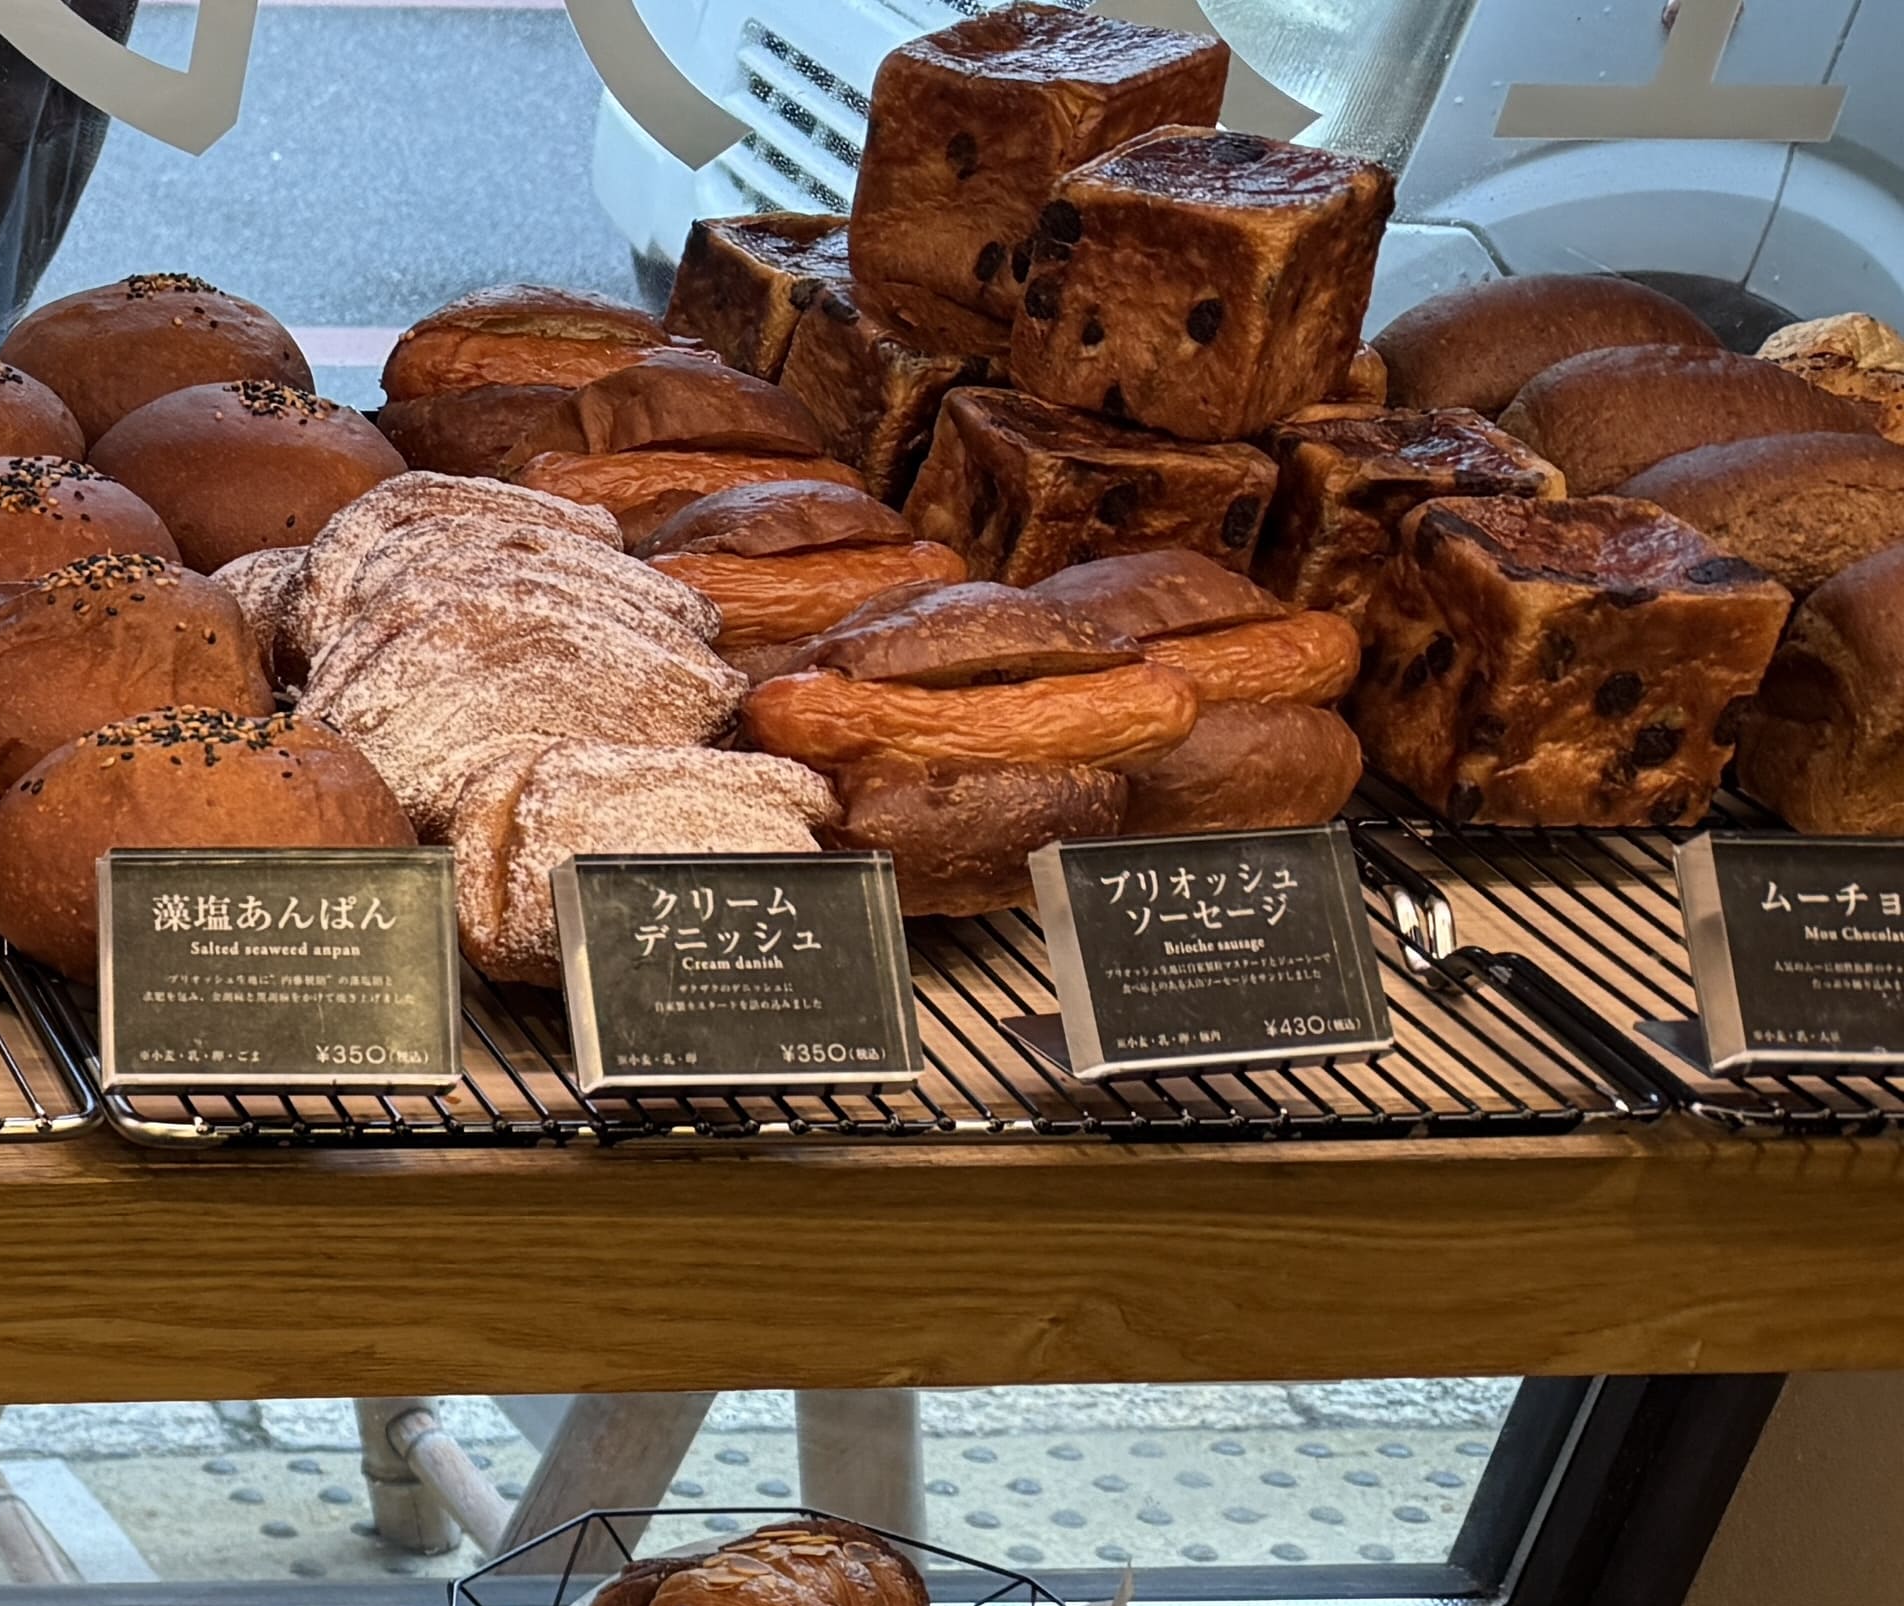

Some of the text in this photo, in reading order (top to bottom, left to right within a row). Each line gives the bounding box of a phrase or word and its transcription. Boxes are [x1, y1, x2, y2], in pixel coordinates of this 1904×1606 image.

[1100, 862, 1298, 905] ブリオッシュ
[151, 893, 398, 933] 藻塩あんぱん
[651, 887, 798, 921] クリーム
[1125, 893, 1289, 936] ソーセージ
[190, 941, 362, 959] Salted seaweed anpan
[634, 921, 823, 957] デニッシュ
[1164, 936, 1266, 957] Brioche sausage
[1805, 926, 1838, 941] Mou
[682, 955, 785, 971] Cream danish
